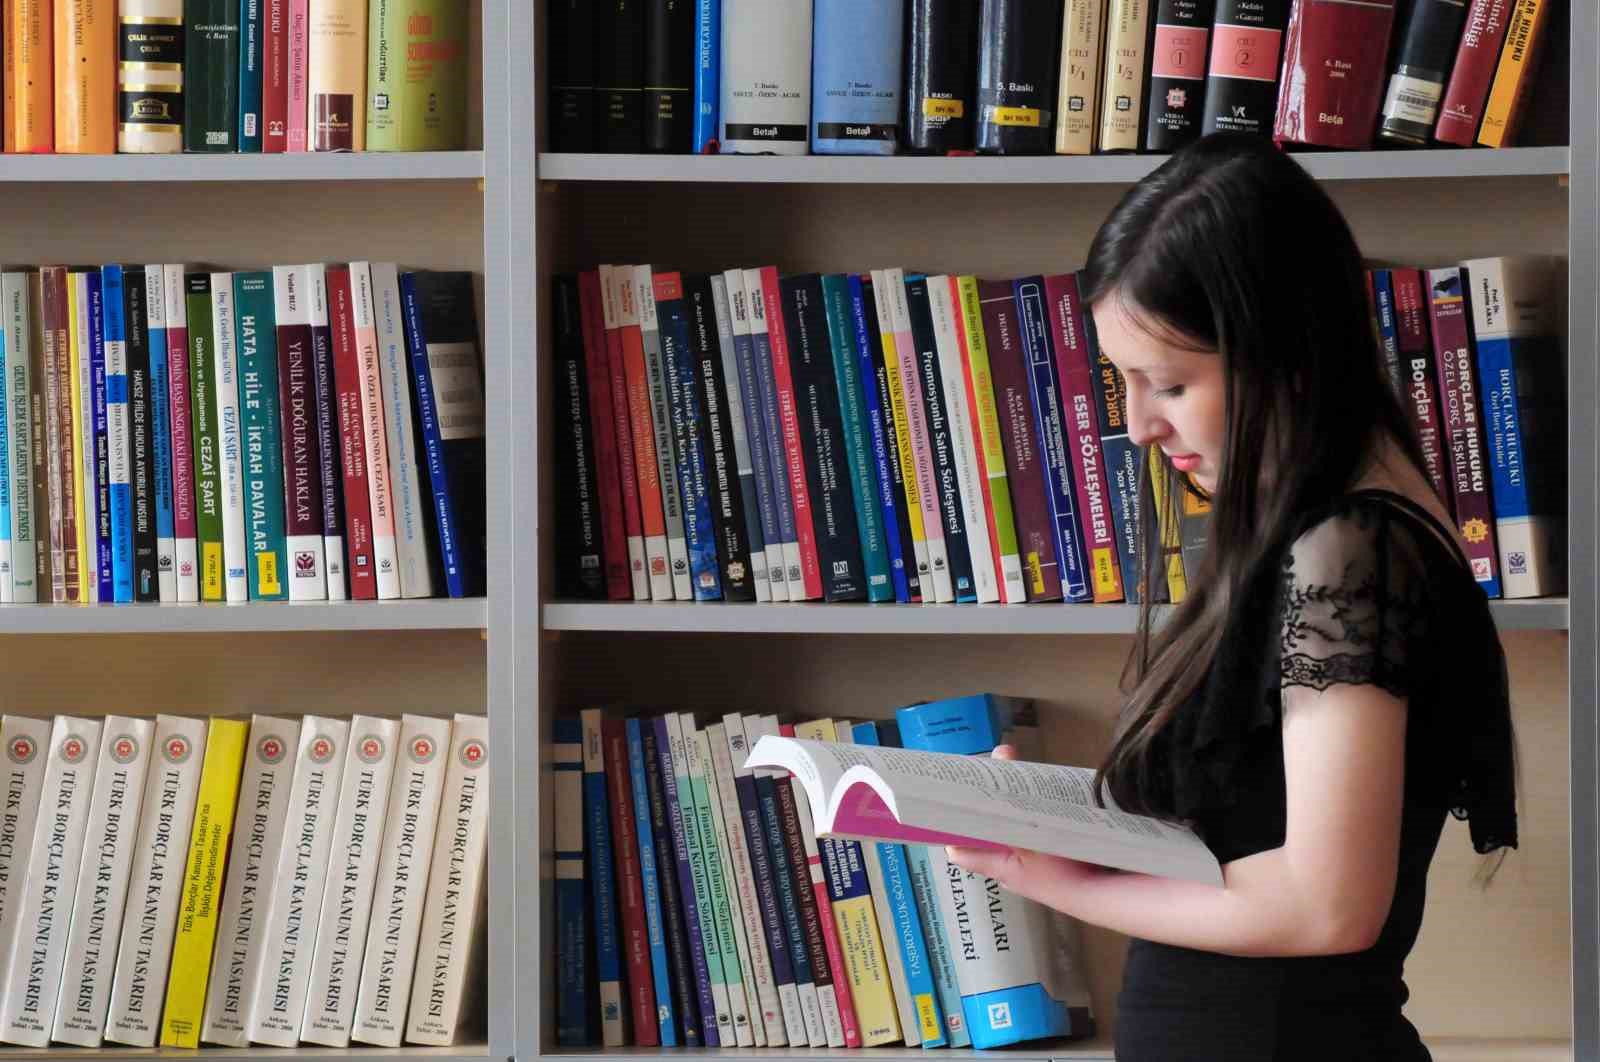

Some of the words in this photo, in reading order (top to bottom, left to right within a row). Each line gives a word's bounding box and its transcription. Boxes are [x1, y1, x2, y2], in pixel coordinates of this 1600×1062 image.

[1240, 52, 1250, 66] 2
[1511, 17, 1531, 62] HUKUKU
[241, 315, 256, 355] HATA
[997, 312, 1010, 351] DUMAN
[244, 372, 263, 408] HİLE
[288, 341, 305, 395] YENİLİK
[921, 350, 943, 429] Promosyonlu
[1102, 367, 1121, 427] BORÇLAR
[1408, 358, 1433, 425] Borçlar
[1442, 350, 1456, 386] ÖZEL
[1453, 347, 1476, 424] BORÇLAR
[1073, 393, 1090, 431] ESER
[1446, 389, 1461, 425] BORÇ
[1497, 368, 1516, 430] BORÇLAR
[134, 425, 144, 458] HUKUKA
[200, 437, 213, 476] CEZAİ
[246, 425, 266, 473] İKRAH
[291, 397, 307, 464] DOĞURAN
[935, 430, 949, 465] Satım
[1450, 428, 1472, 493] İLİŞKİLERİ
[1464, 426, 1485, 492] HUKUKU
[1504, 431, 1522, 487] HUKUKU
[201, 480, 214, 516] ŞART
[294, 466, 311, 522] HAKLAR
[939, 467, 961, 535] Sözleşmesi
[1078, 433, 1108, 544] SÖZLEŞMELERİ
[6, 769, 26, 810] TÜRK
[56, 769, 76, 810] TÜRK
[107, 769, 127, 810] TÜRK
[160, 769, 179, 810] TÜRK
[255, 769, 274, 810] TÜRK
[304, 769, 324, 810] TÜRK
[353, 769, 373, 810] TÜRK
[404, 769, 424, 810] TÜRK
[456, 774, 476, 815] TÜRK
[44, 813, 67, 883] BORÇLAR
[96, 813, 119, 883] BORÇLAR
[149, 813, 171, 883] BORÇLAR
[244, 813, 266, 883] BORÇLAR
[292, 812, 315, 883] BORÇLAR
[342, 813, 365, 883] BORÇLAR
[393, 813, 416, 883] BORÇLAR
[445, 818, 468, 886] BORÇLAR
[35, 885, 56, 945] KANUNU
[87, 885, 107, 945] KANUNU
[139, 885, 159, 945] KANUNU
[235, 885, 255, 945] KANUNU
[283, 885, 303, 945] KANUNU
[334, 885, 354, 945] KANUNU
[384, 885, 404, 945] KANUNU
[437, 888, 457, 949] KANUNU
[690, 851, 706, 900] Kiralama
[699, 901, 716, 957] Sözleşmesi
[24, 948, 46, 1012] TASARISI
[76, 948, 98, 1012] TASARISI
[128, 948, 150, 1012] TASARISI
[224, 948, 246, 1012] TASARISI
[272, 948, 294, 1012] TASARISI
[324, 948, 345, 1012] TASARISI
[374, 948, 395, 1012] TASARISI
[427, 953, 448, 1016] TASARISI
